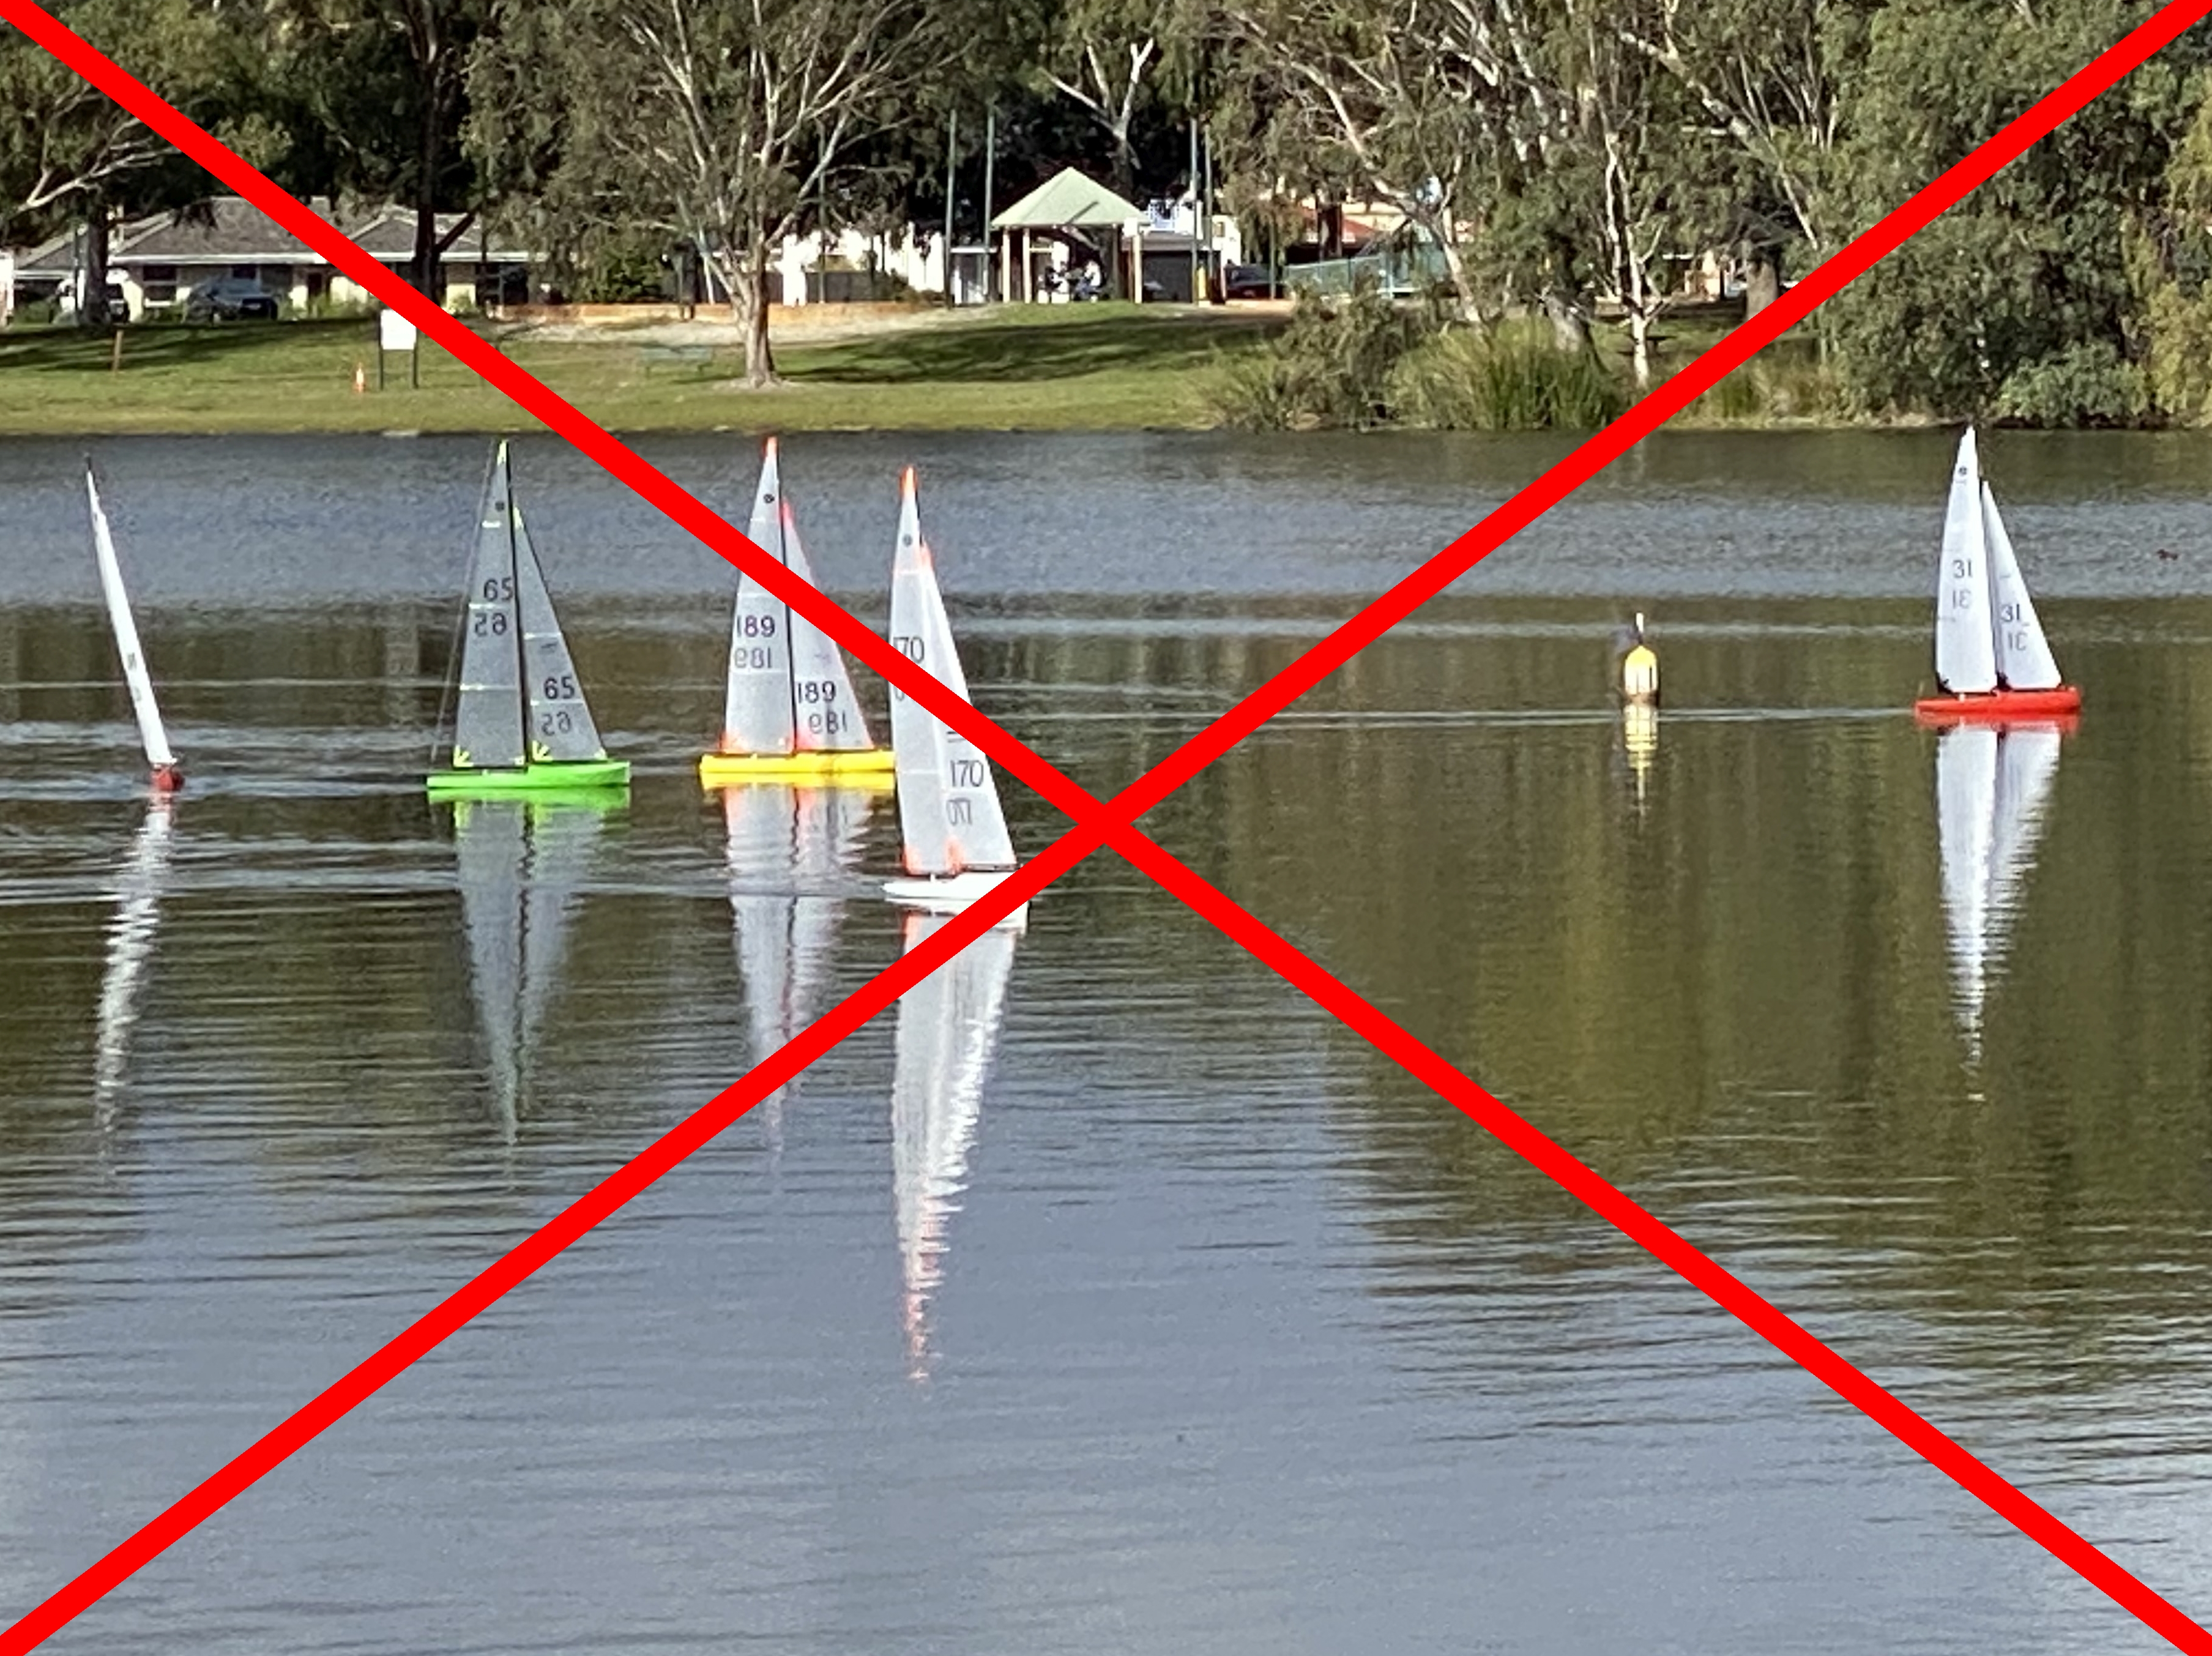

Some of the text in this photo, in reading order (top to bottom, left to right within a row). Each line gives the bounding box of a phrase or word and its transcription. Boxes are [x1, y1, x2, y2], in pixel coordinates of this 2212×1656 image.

[1952, 558, 1973, 579] 31
[483, 577, 513, 603] 65
[2000, 603, 2020, 623] 31
[736, 615, 775, 638] 189
[543, 676, 575, 701] 65
[797, 681, 836, 704] 189
[950, 759, 984, 788] 170
